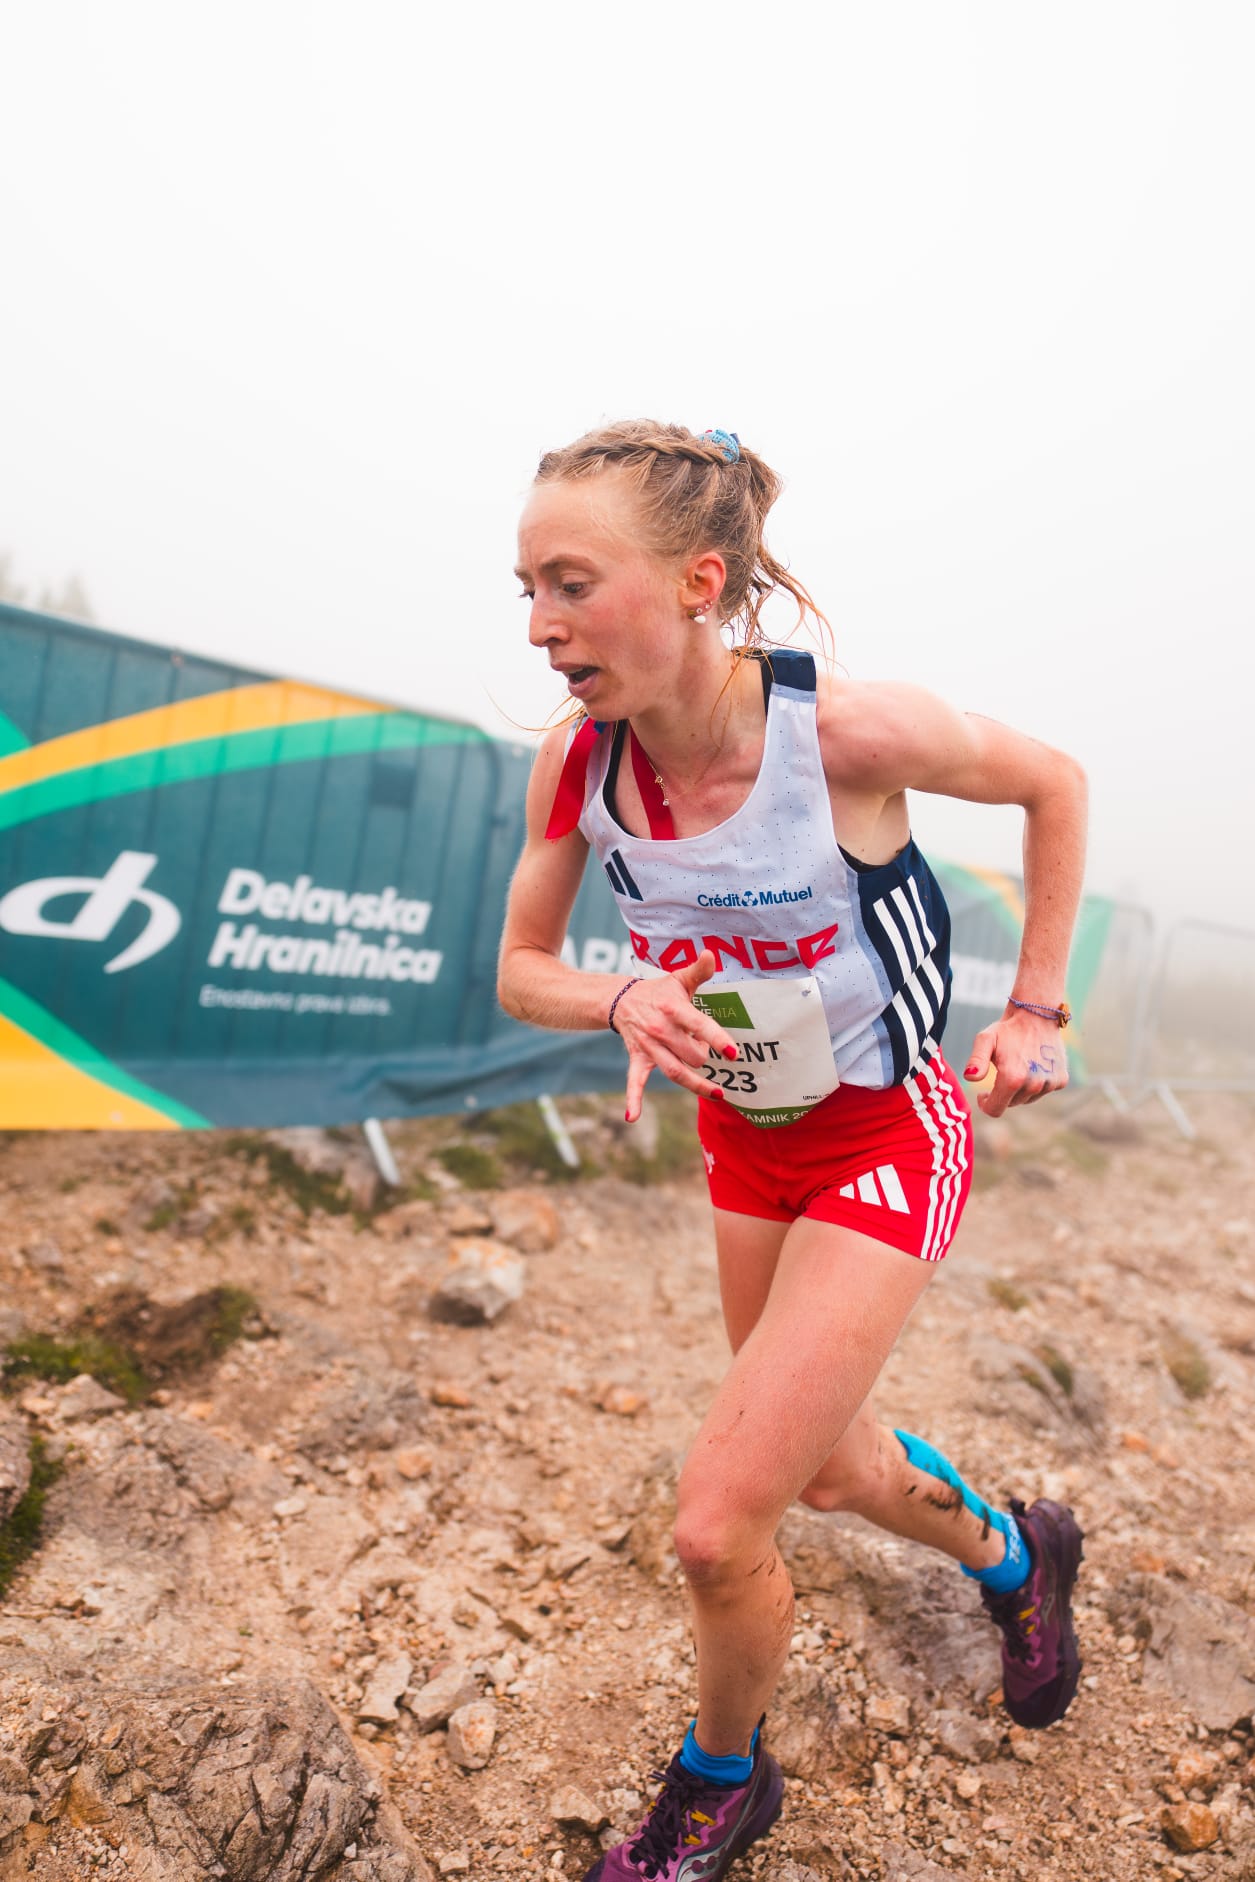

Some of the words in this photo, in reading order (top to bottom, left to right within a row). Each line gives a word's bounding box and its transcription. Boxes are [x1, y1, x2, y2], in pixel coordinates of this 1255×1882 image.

[217, 867, 433, 935] Delavska
[697, 892, 740, 907] Crédit
[758, 886, 813, 905] Mutuel
[206, 921, 443, 983] Hranilnica
[701, 1064, 758, 1093] 223
[739, 1111, 789, 1124] AMNIK
